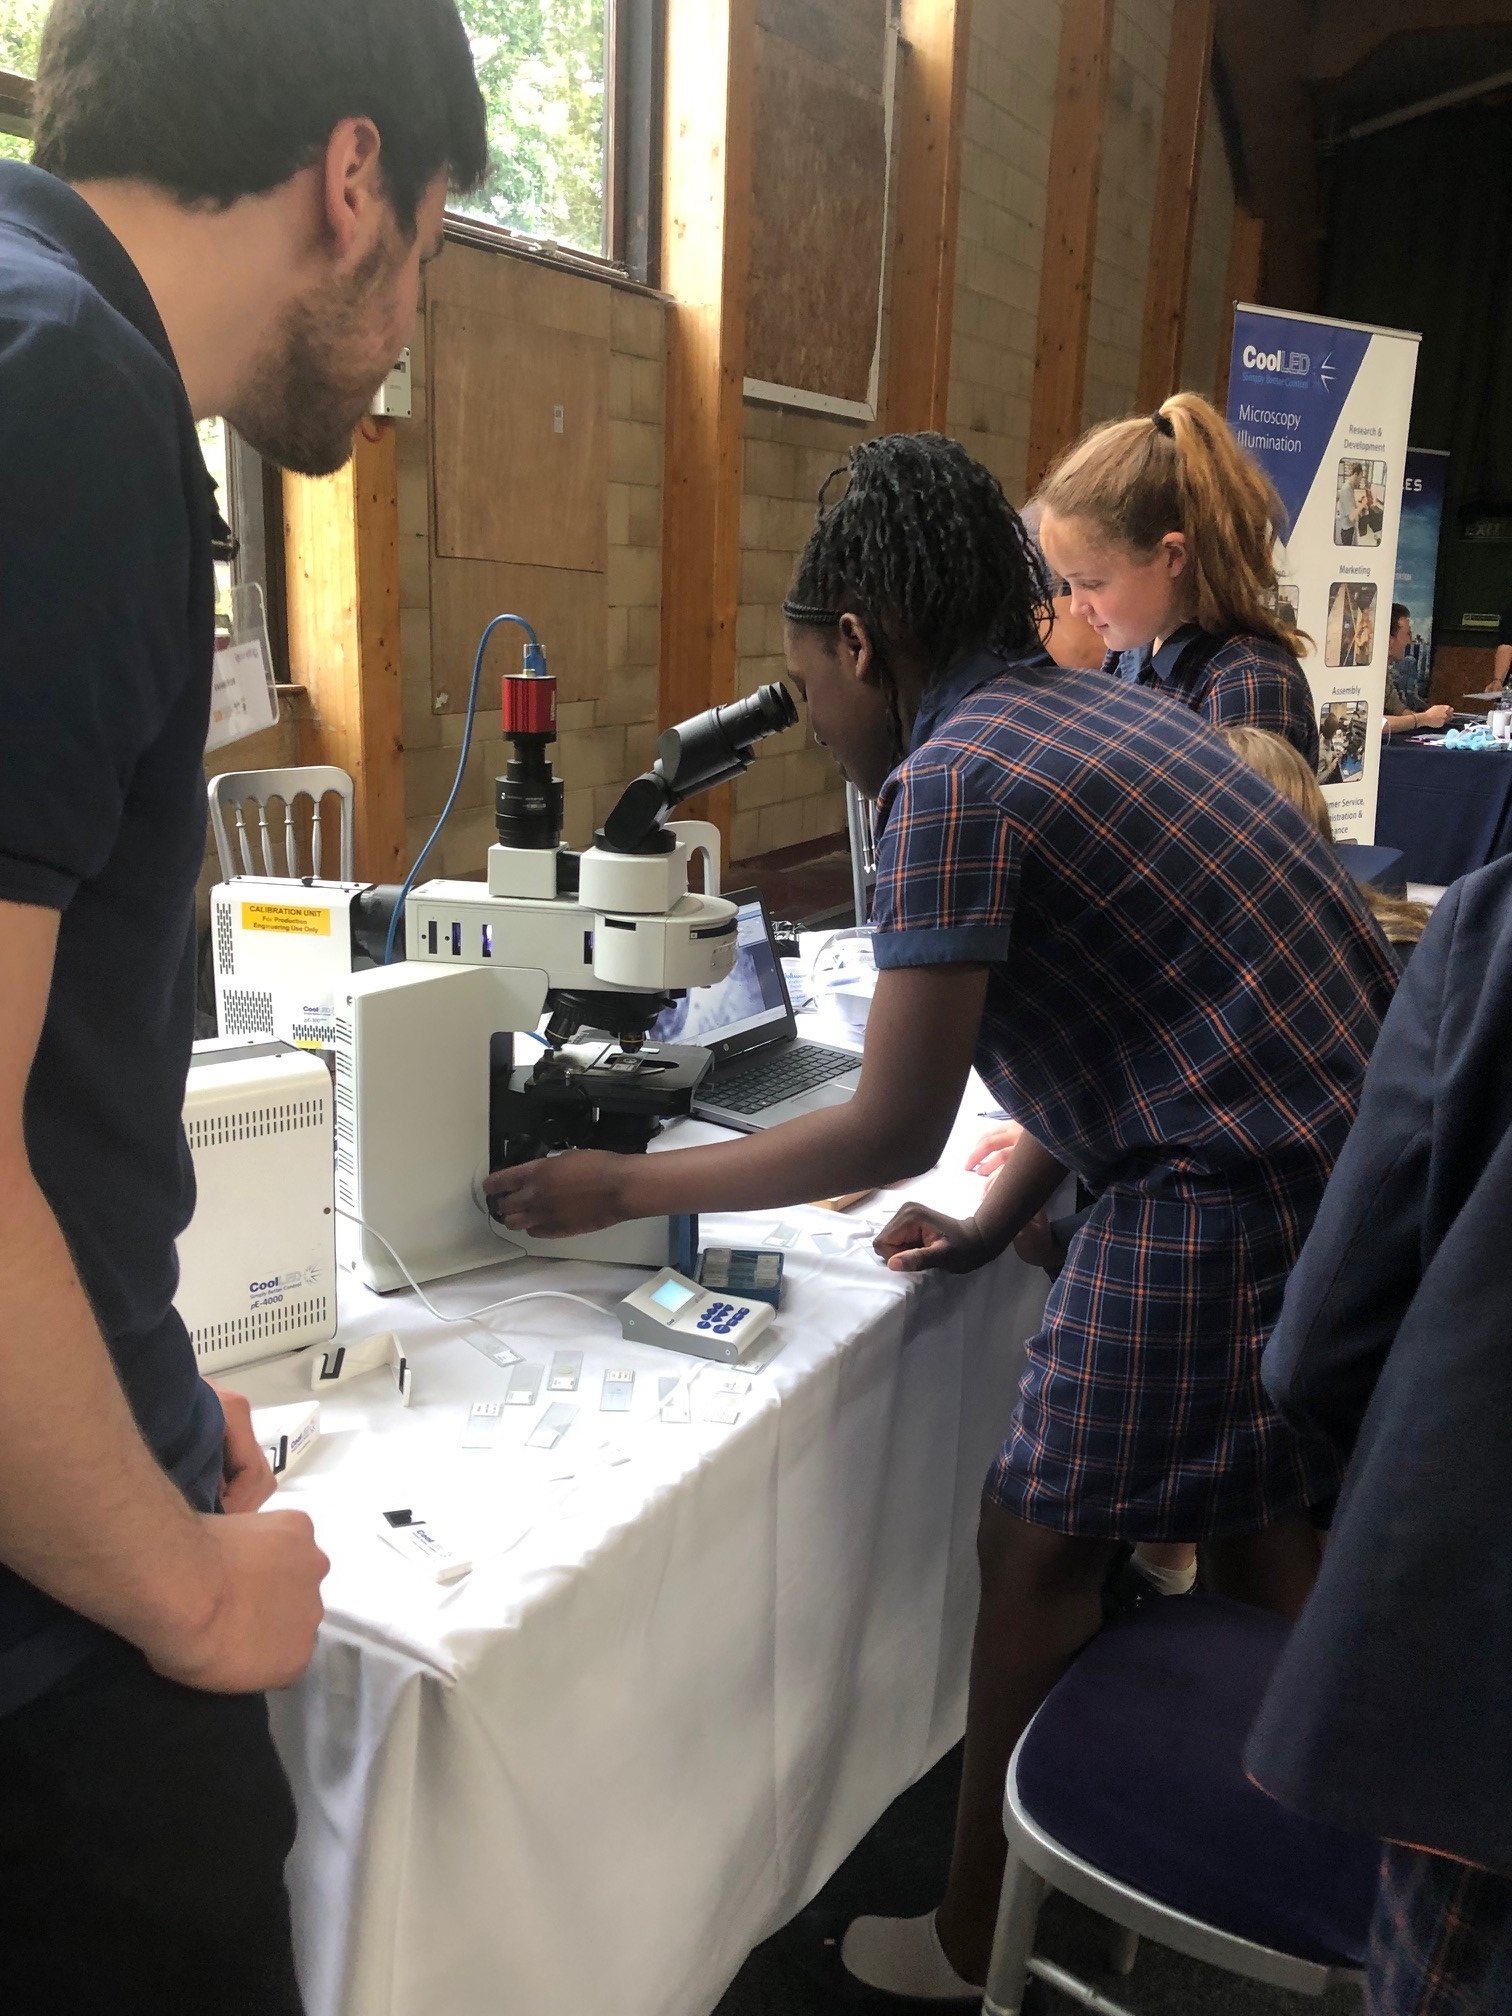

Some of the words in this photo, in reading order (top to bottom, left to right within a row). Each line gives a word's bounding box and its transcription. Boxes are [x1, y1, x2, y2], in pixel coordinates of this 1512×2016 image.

[1243, 345, 1310, 375] CoolLED
[1239, 404, 1302, 431] Microscopy
[1349, 424, 1375, 437] Research
[1376, 427, 1382, 436] &
[1237, 430, 1302, 453] Illumination
[1344, 439, 1386, 453] Development
[1339, 564, 1371, 577] Marketing
[1332, 685, 1361, 696] Assembly
[249, 905, 302, 916] CALIBRATION
[303, 909, 322, 917] UNIT
[253, 922, 290, 931] Engineering
[274, 916, 307, 924] Production
[303, 1005, 330, 1013] CoolED
[250, 1294, 283, 1310] pE-4000
